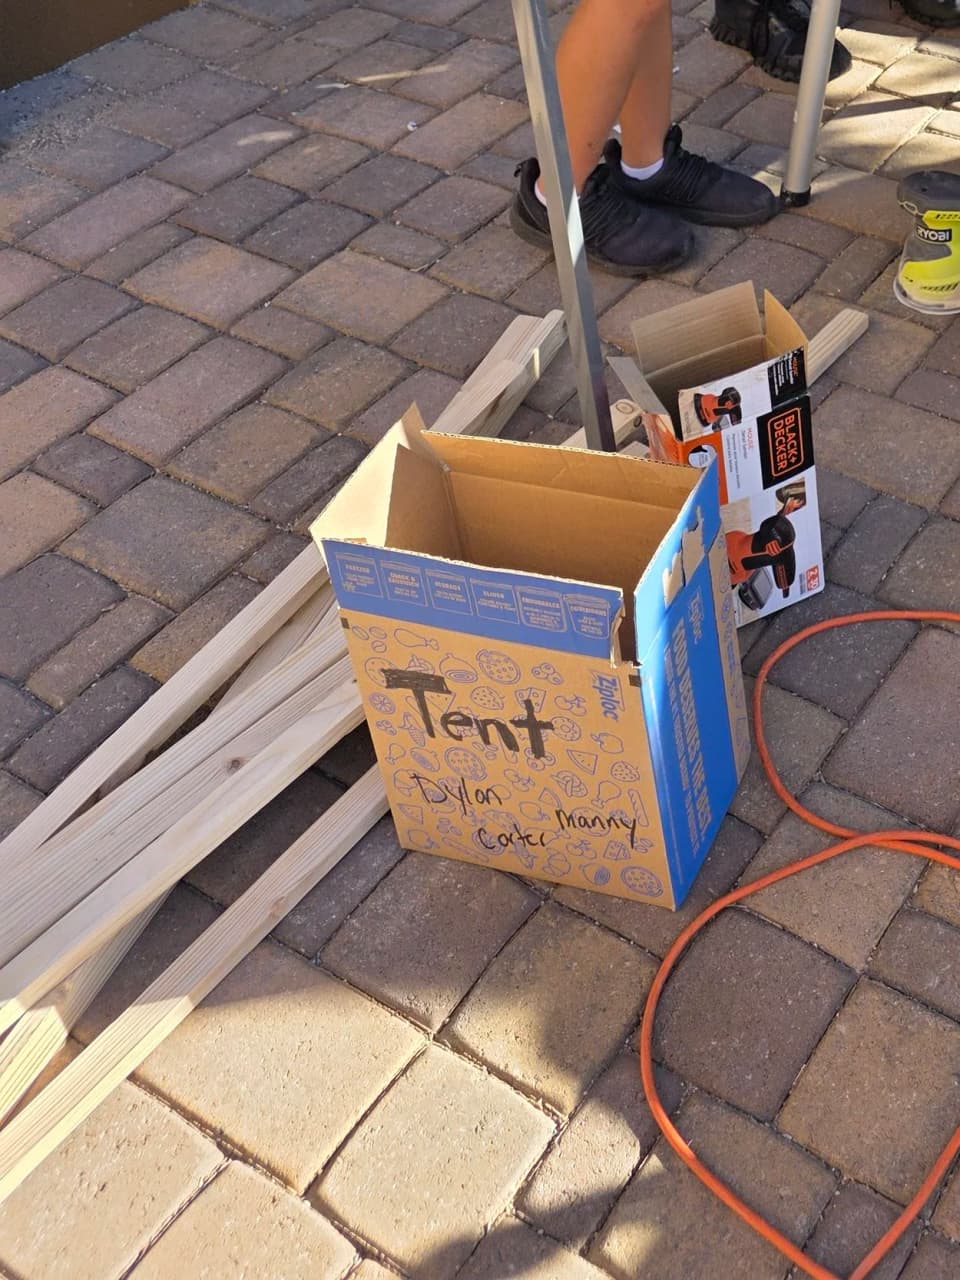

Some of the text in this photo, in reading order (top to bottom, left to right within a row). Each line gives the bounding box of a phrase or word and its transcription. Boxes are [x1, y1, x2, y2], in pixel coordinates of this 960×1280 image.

[917, 226, 950, 241] RYOBI
[774, 419, 788, 471] DECKER
[785, 414, 798, 463] BLACK+
[381, 668, 555, 760] Tent
[592, 674, 620, 722] Ziploc
[679, 665, 700, 762] DESERVES
[691, 751, 705, 798] THE
